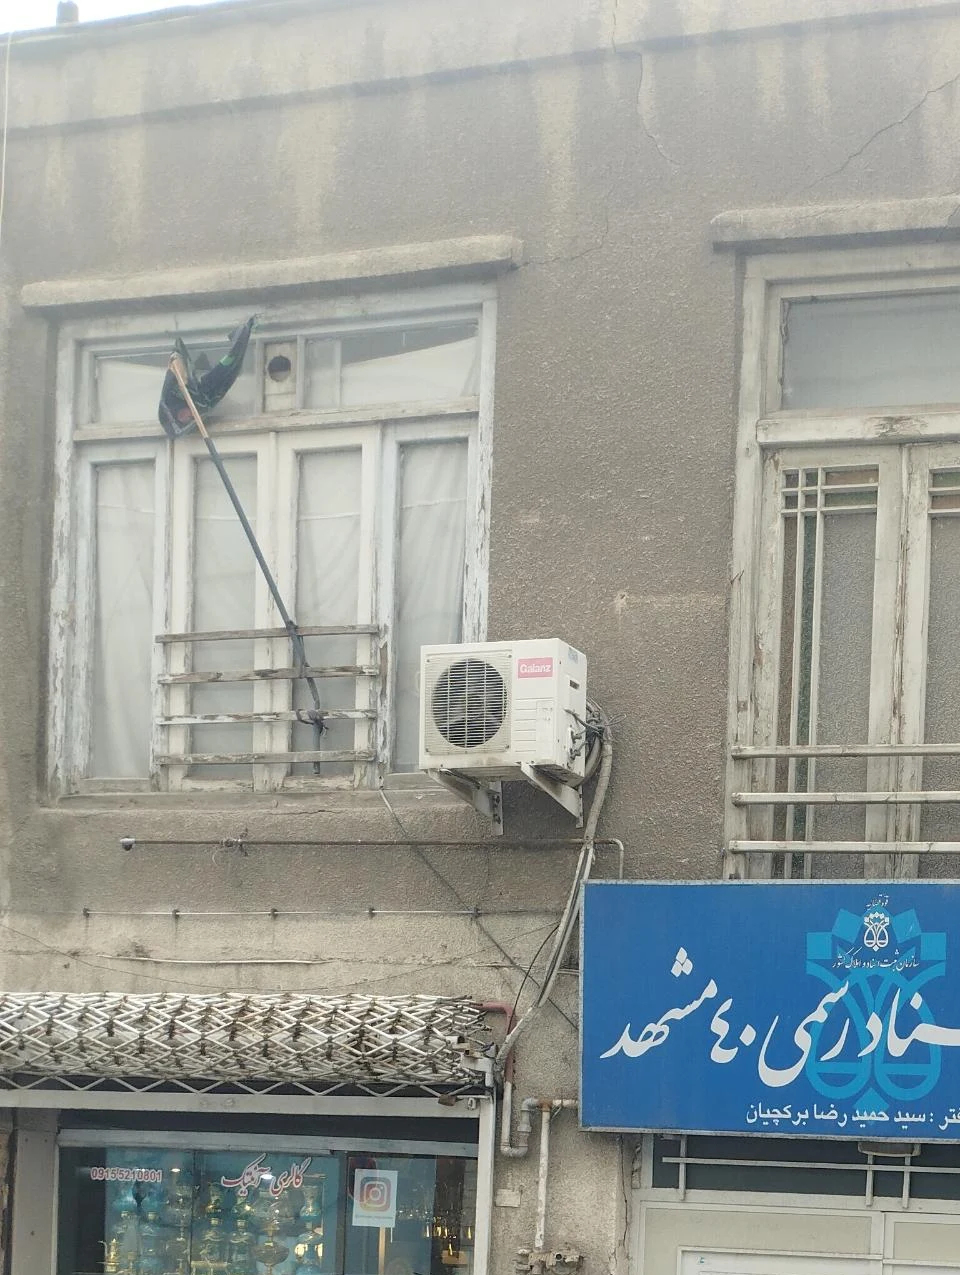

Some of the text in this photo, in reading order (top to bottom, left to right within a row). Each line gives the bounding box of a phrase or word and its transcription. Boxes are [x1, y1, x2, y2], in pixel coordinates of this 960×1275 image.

[519, 663, 552, 674] Galanz
[599, 946, 718, 1059] مشهد
[757, 980, 850, 1088] رسمی
[813, 1103, 848, 1128] رضا
[851, 1108, 890, 1128] حمید
[893, 1109, 926, 1130] سید
